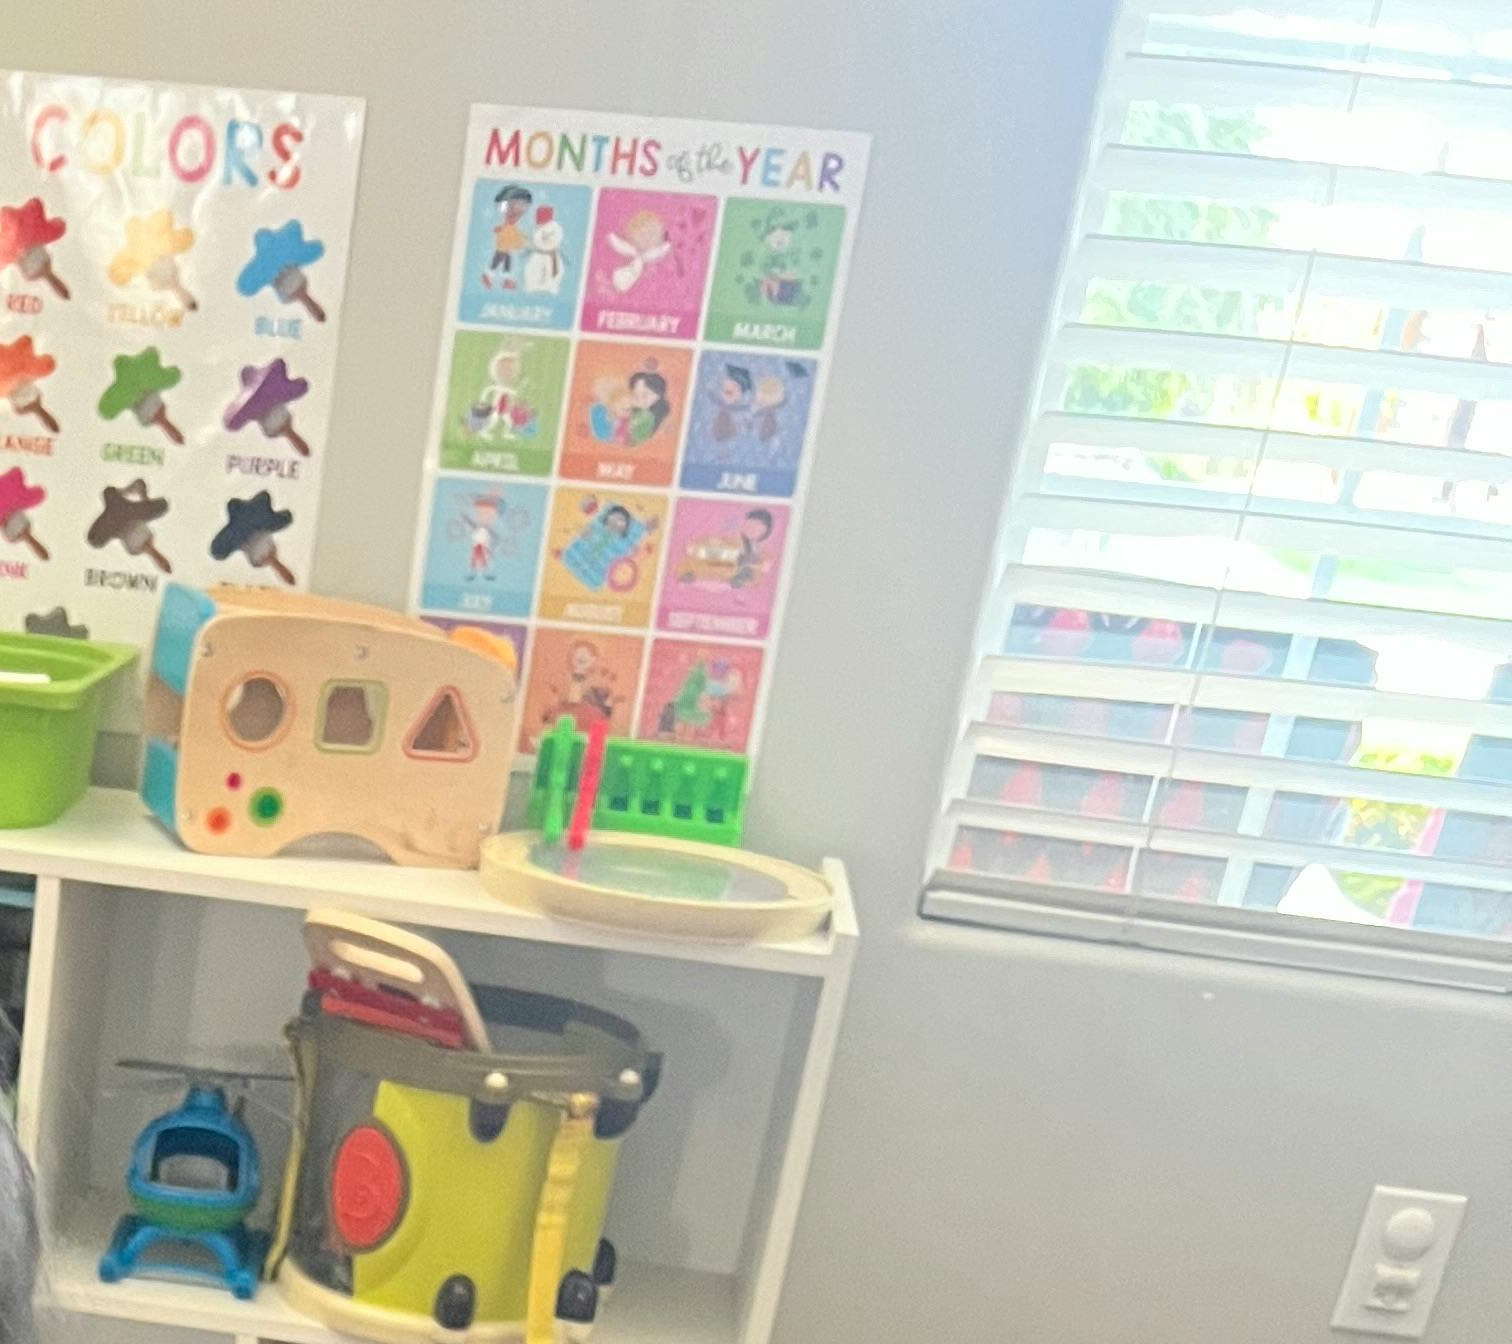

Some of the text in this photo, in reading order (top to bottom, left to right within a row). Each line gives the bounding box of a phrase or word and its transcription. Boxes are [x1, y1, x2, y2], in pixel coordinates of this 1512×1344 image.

[31, 104, 305, 190] COLORS
[484, 127, 845, 194] MONTHS of the YEAR
[6, 294, 44, 316] RED
[107, 302, 185, 328] YELLOW
[254, 316, 303, 339] BLUE
[596, 309, 682, 335] FEBRUARY
[732, 321, 797, 343] MARCH
[101, 442, 165, 467] GREEN
[226, 454, 301, 480] PURPLE
[597, 460, 637, 481] MAY
[84, 567, 159, 593] BROWN
